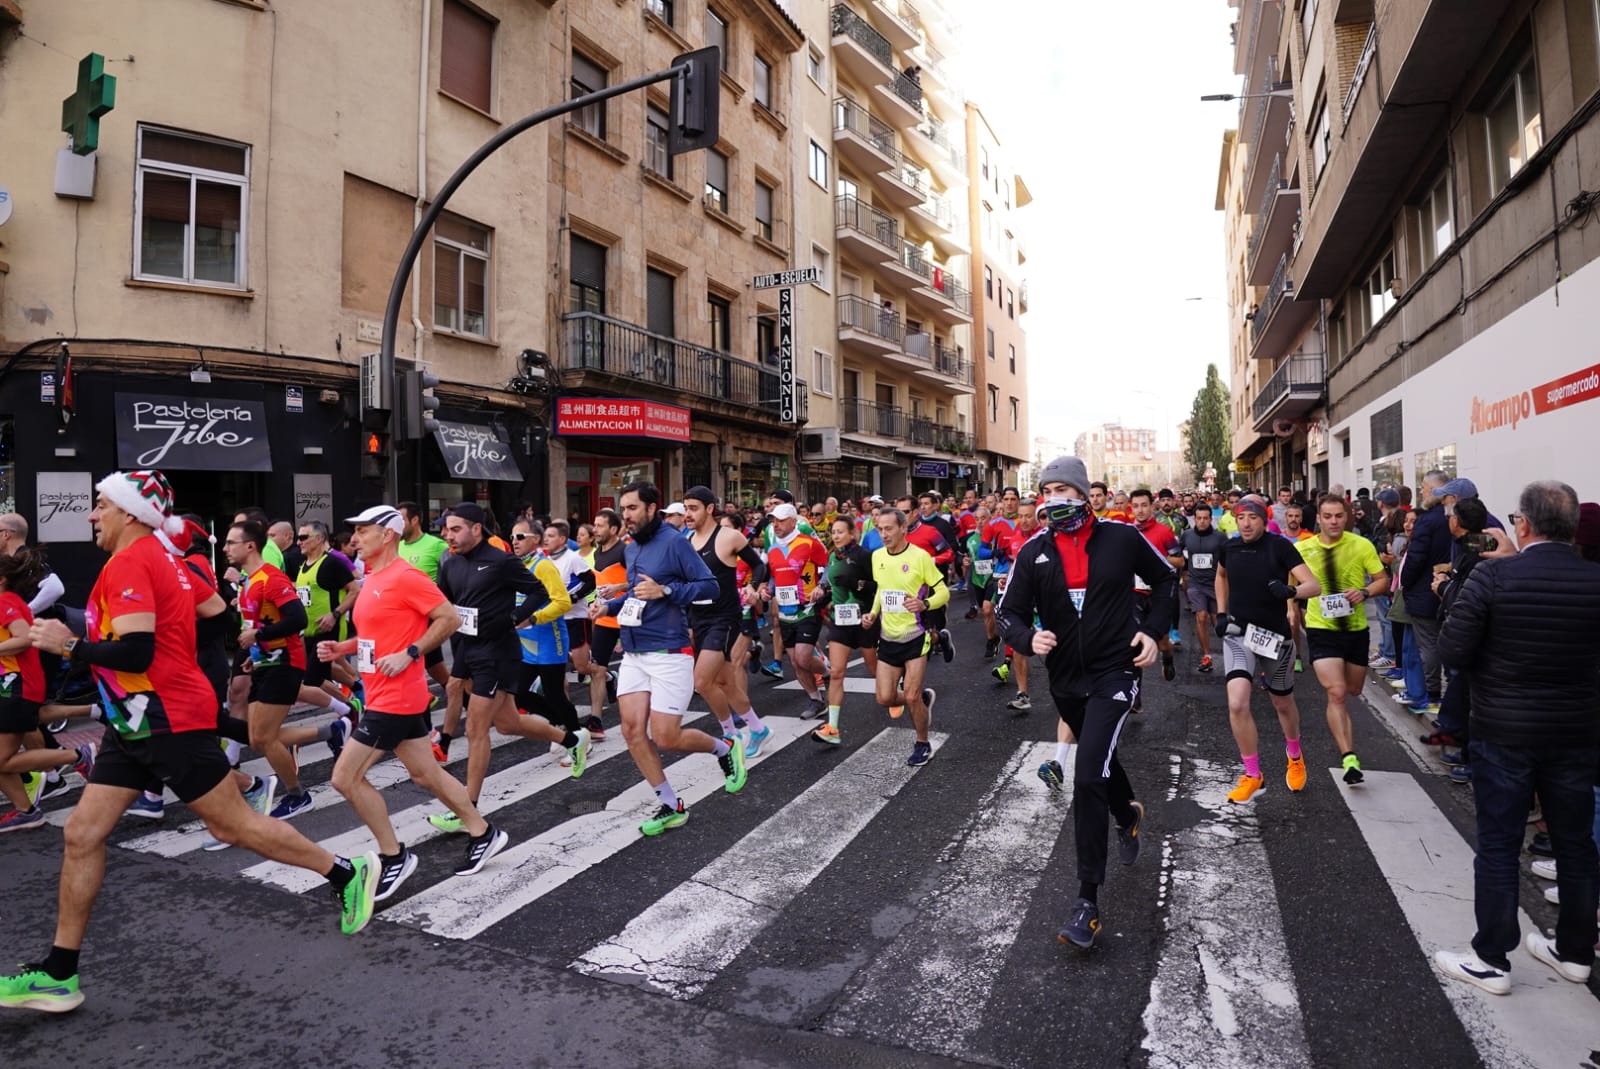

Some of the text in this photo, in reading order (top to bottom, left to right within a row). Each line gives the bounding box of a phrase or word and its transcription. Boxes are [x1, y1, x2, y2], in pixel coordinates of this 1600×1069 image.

[780, 268, 817, 285] ESCUELA
[781, 291, 793, 420] SAN ANTONIO
[1470, 371, 1599, 435] Alcampo supermercado
[133, 401, 252, 431] Pastelería
[559, 419, 633, 431] ALIMENTACION
[885, 595, 898, 606] 1911
[1326, 600, 1344, 611] 644
[1250, 632, 1272, 648] 1567
